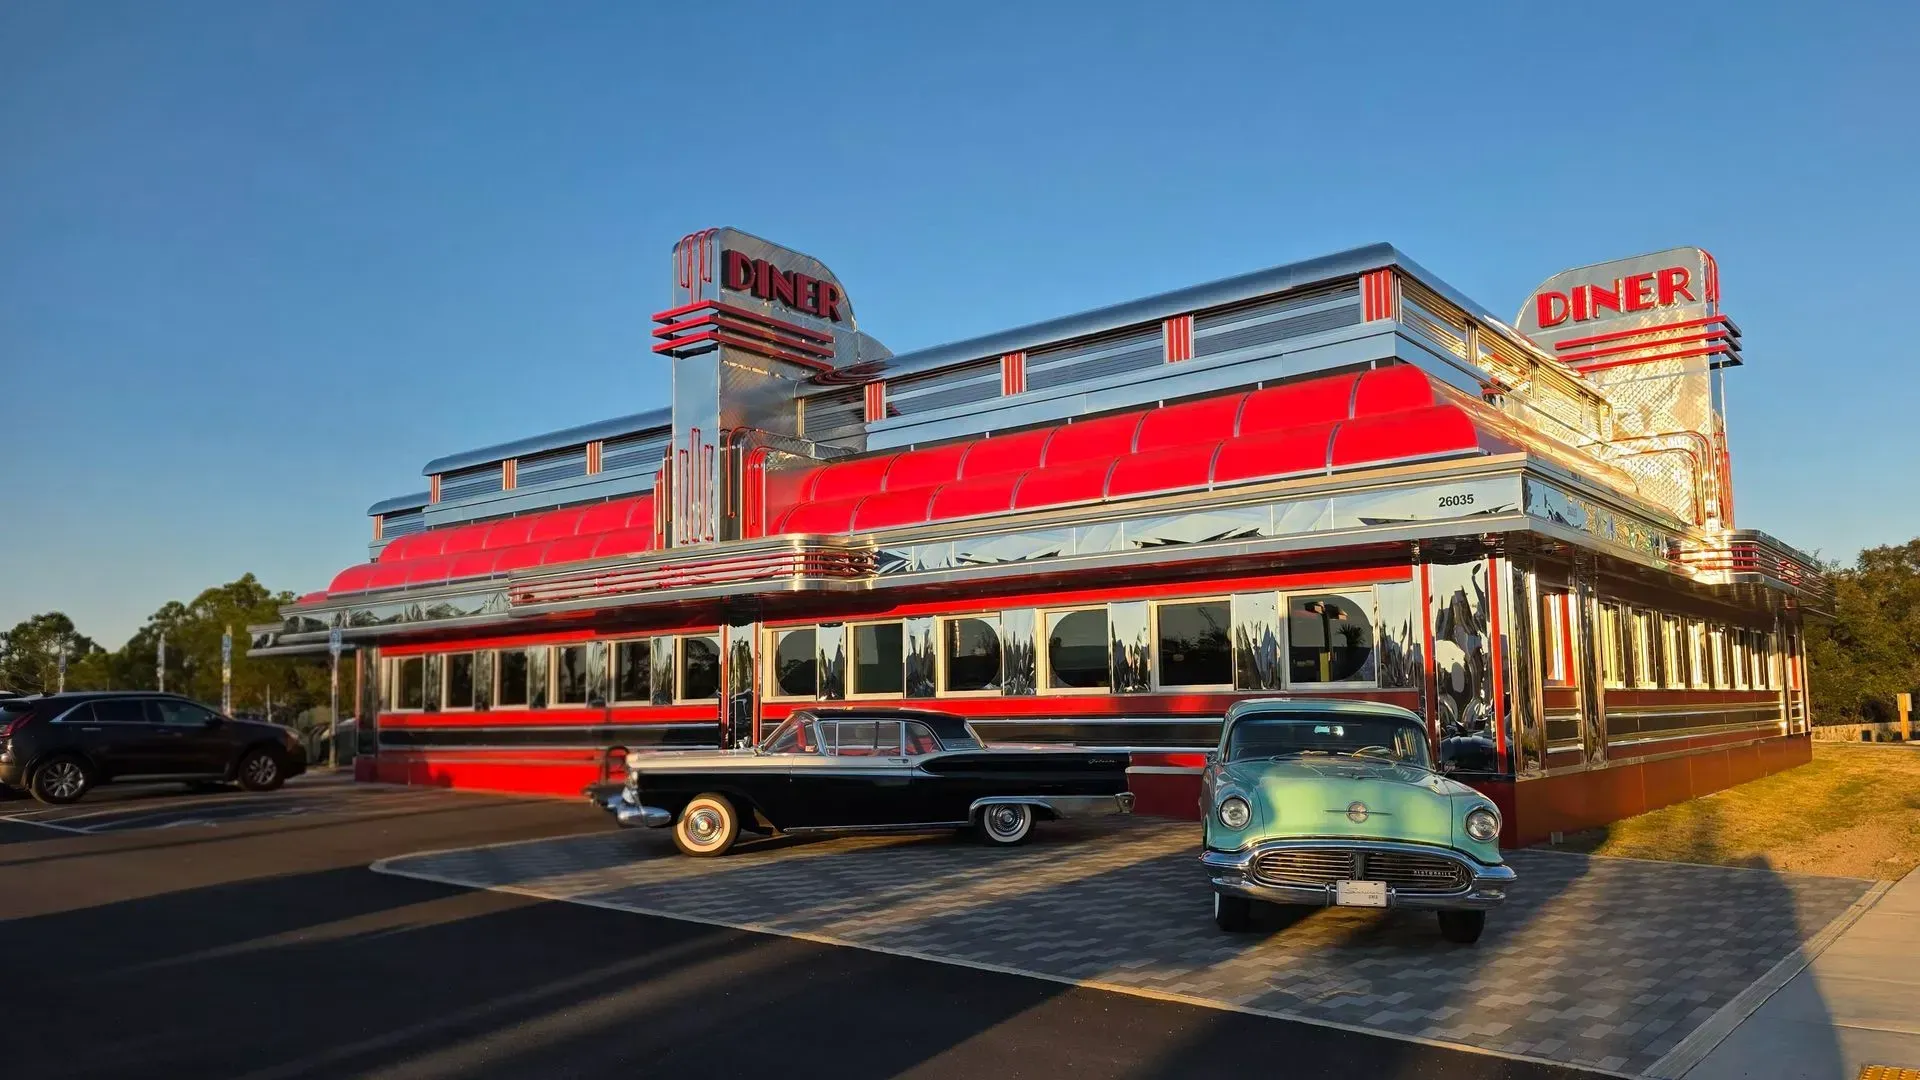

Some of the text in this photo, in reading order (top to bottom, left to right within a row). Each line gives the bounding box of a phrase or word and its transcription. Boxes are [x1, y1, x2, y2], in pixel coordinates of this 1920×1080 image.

[721, 249, 842, 322] DINER
[1537, 266, 1697, 328] DINER
[1438, 493, 1474, 507] 26035
